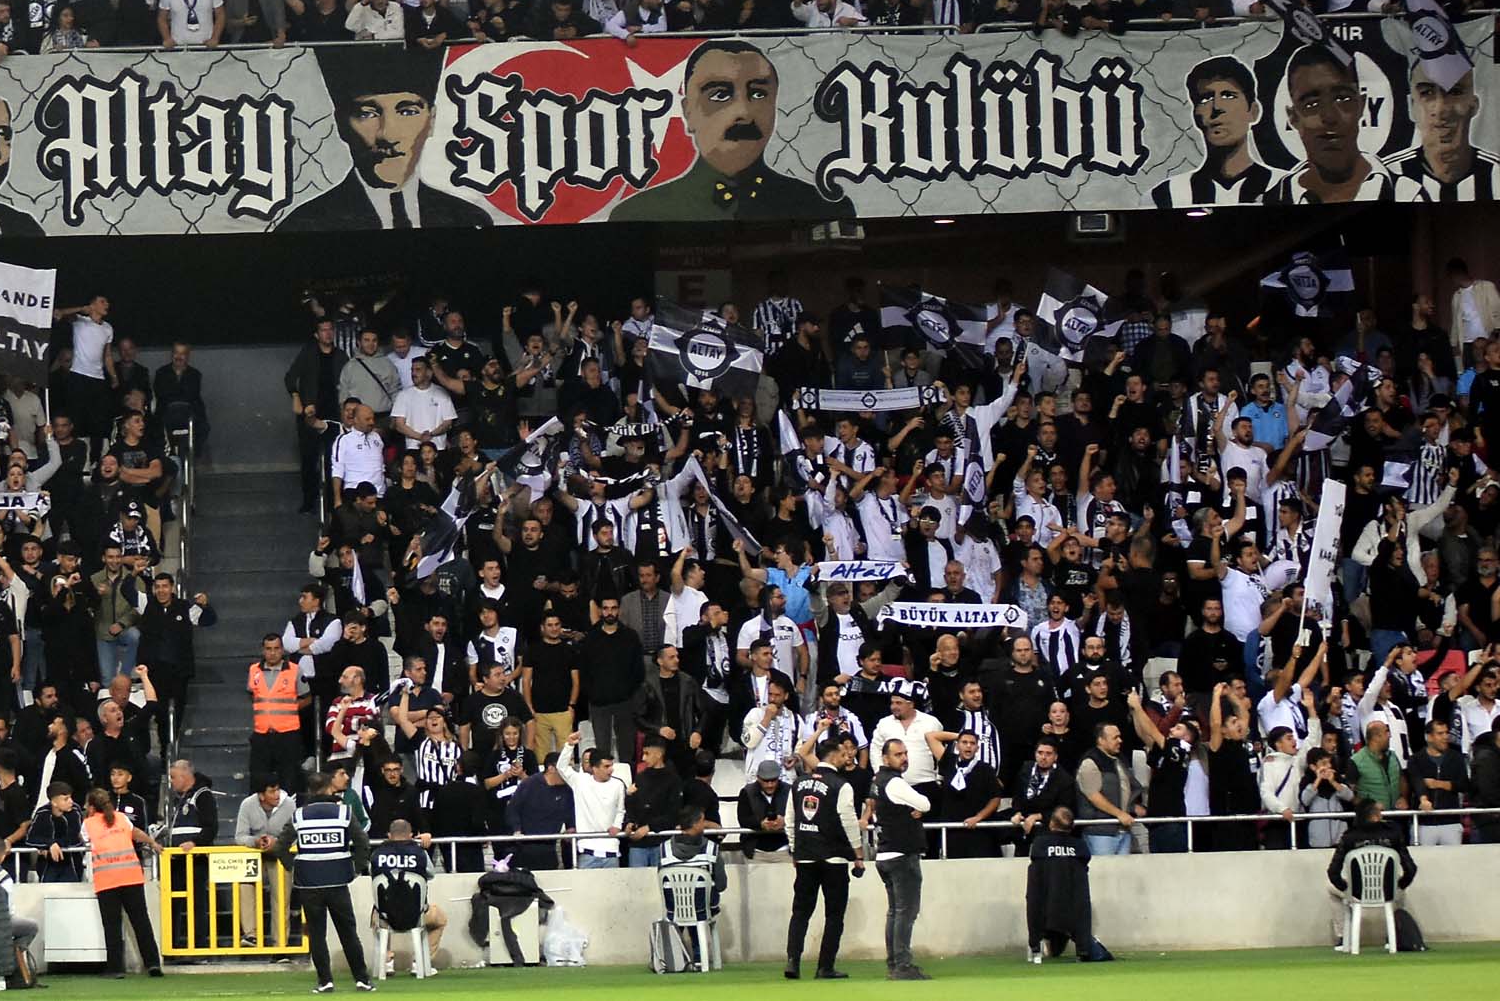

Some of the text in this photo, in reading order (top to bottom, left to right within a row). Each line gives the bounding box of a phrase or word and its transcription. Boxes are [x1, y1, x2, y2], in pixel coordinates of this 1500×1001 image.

[1413, 24, 1444, 47] ALTAY
[43, 57, 1145, 221] Altay Spor Kulübü
[689, 343, 722, 360] ALTAY
[899, 605, 1000, 624] BÜYÜK ALTAY
[302, 833, 339, 844] POLİS
[378, 854, 417, 868] POLİS
